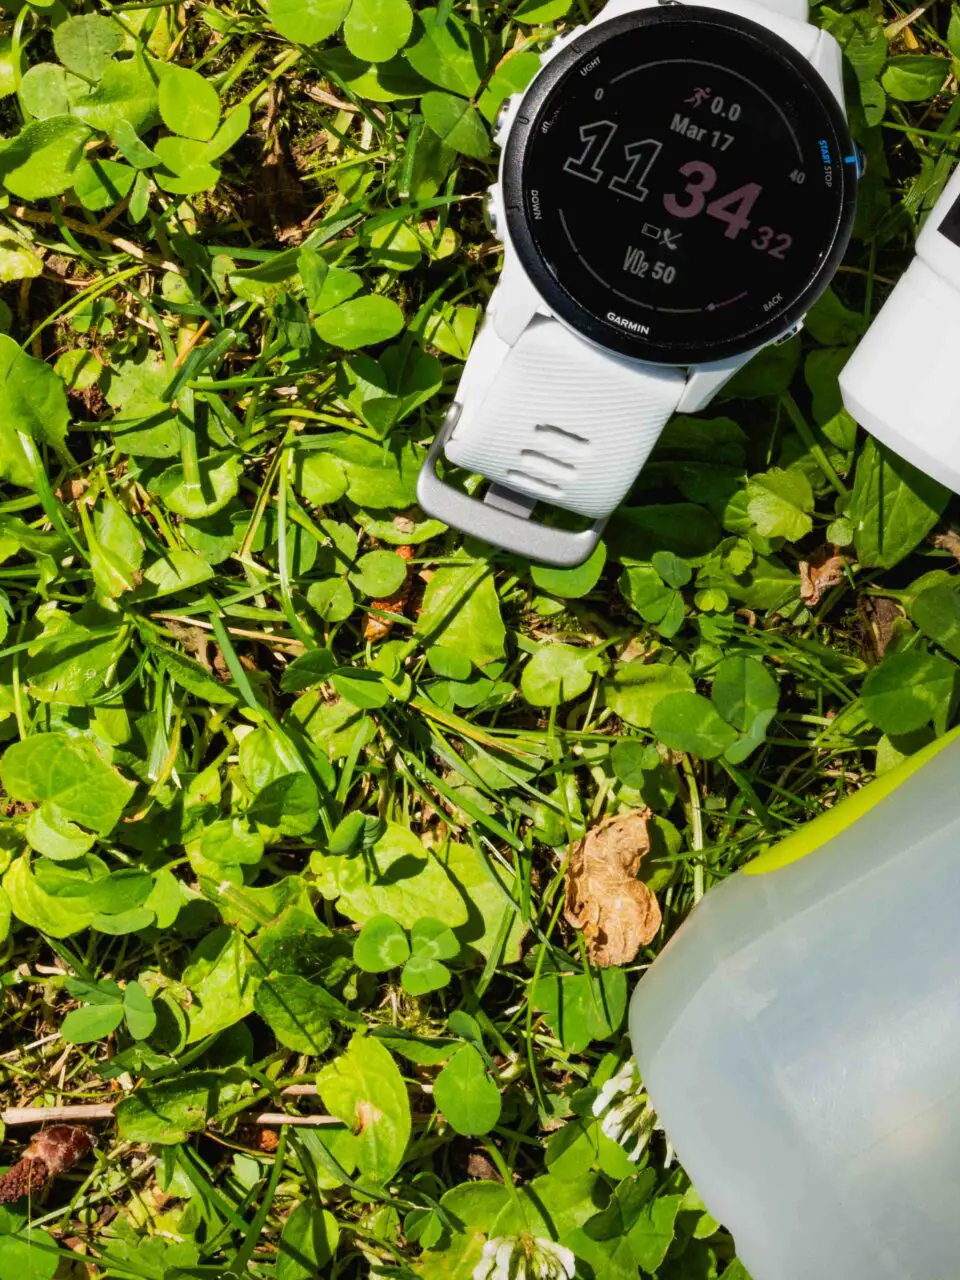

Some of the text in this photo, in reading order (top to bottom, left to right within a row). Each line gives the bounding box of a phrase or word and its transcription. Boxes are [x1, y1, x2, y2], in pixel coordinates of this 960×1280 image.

[580, 56, 602, 77] LIGHT
[594, 87, 605, 101] 0
[711, 96, 742, 121] 0.0
[670, 113, 735, 152] Mar 17
[788, 168, 807, 185] 40
[824, 165, 833, 188] STOP
[531, 189, 542, 220] DOWN
[662, 160, 763, 240] 34
[750, 225, 793, 260] 32
[651, 260, 677, 285] 50
[762, 292, 784, 312] BACK
[606, 311, 651, 335] GARMIN
